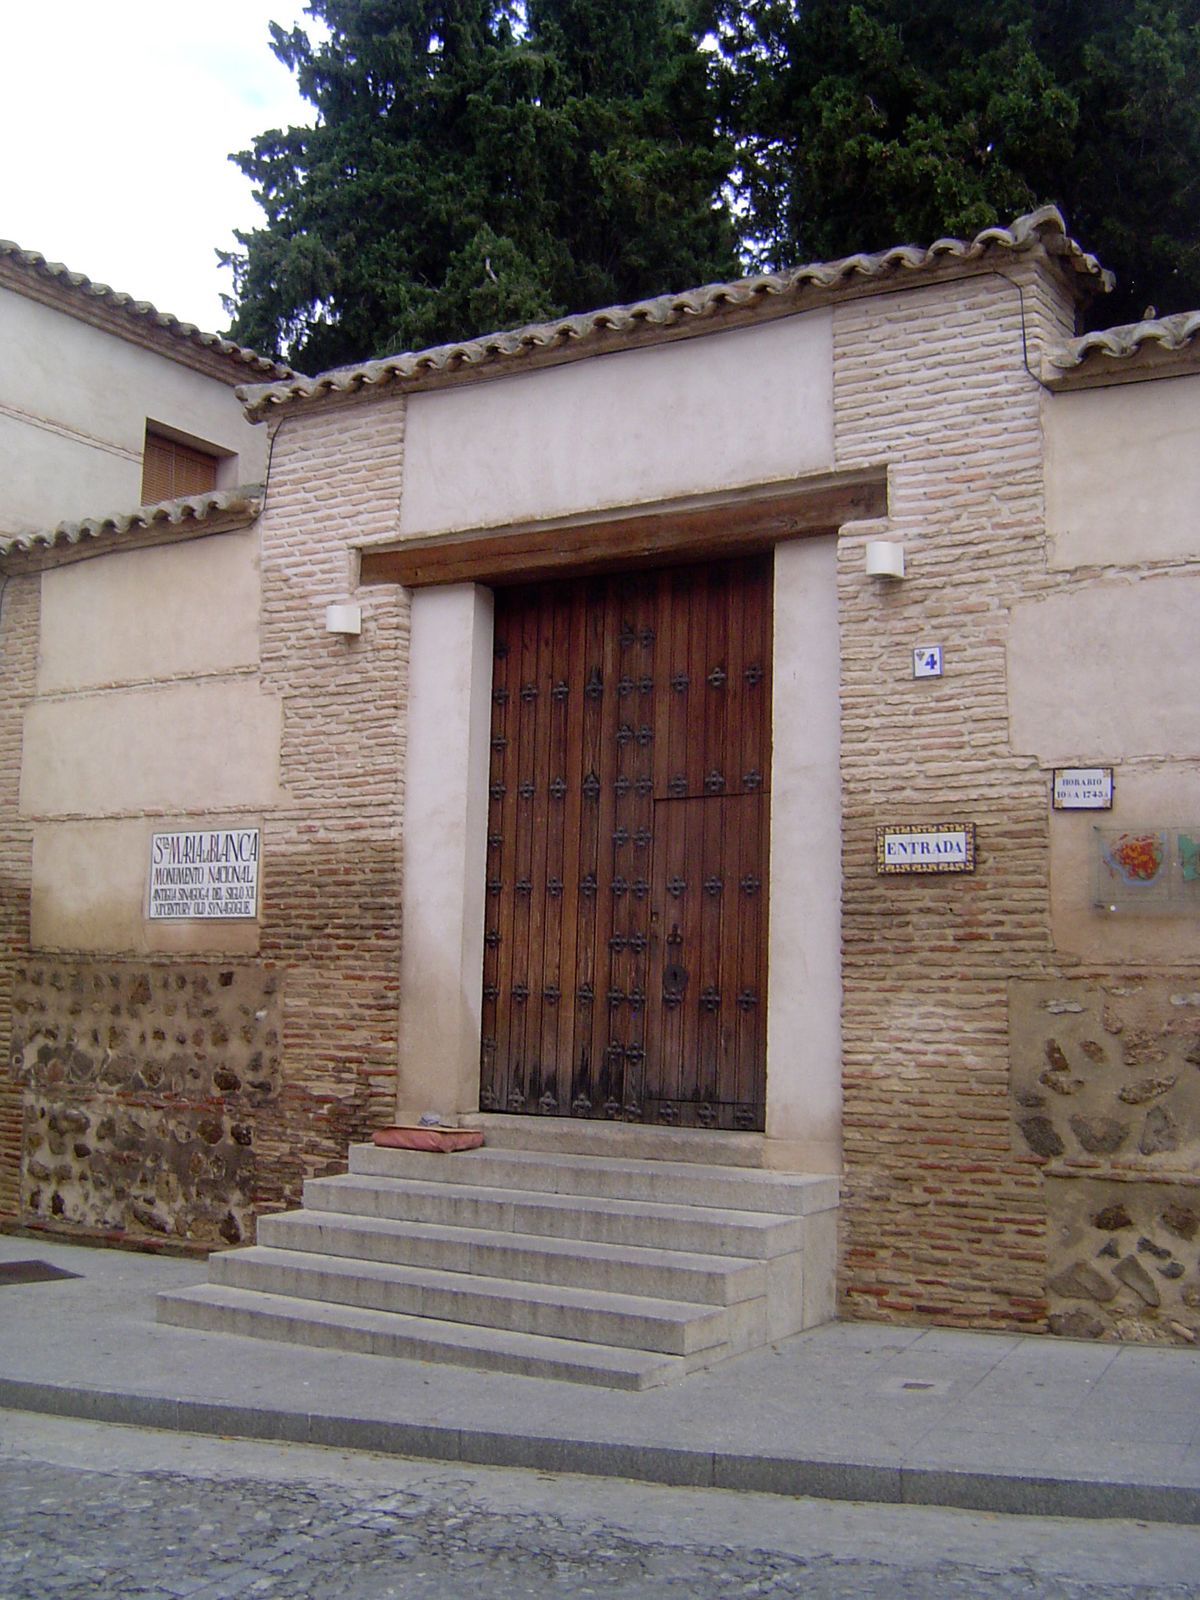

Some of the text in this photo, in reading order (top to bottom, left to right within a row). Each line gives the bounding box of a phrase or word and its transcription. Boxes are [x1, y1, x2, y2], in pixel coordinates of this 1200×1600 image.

[924, 653, 937, 670] 4
[1062, 778, 1102, 787] HORARIO
[168, 834, 203, 865] MARIA
[209, 832, 258, 863] BLANCA
[886, 840, 963, 856] ENTRADA
[153, 865, 254, 886] MONUMENTO NACIONAL
[178, 887, 210, 901] SINAGOGA
[212, 886, 223, 901] DEL
[225, 886, 245, 900] SIGLO
[194, 901, 206, 915] OLD
[207, 900, 251, 915] SYNAGOGUE
